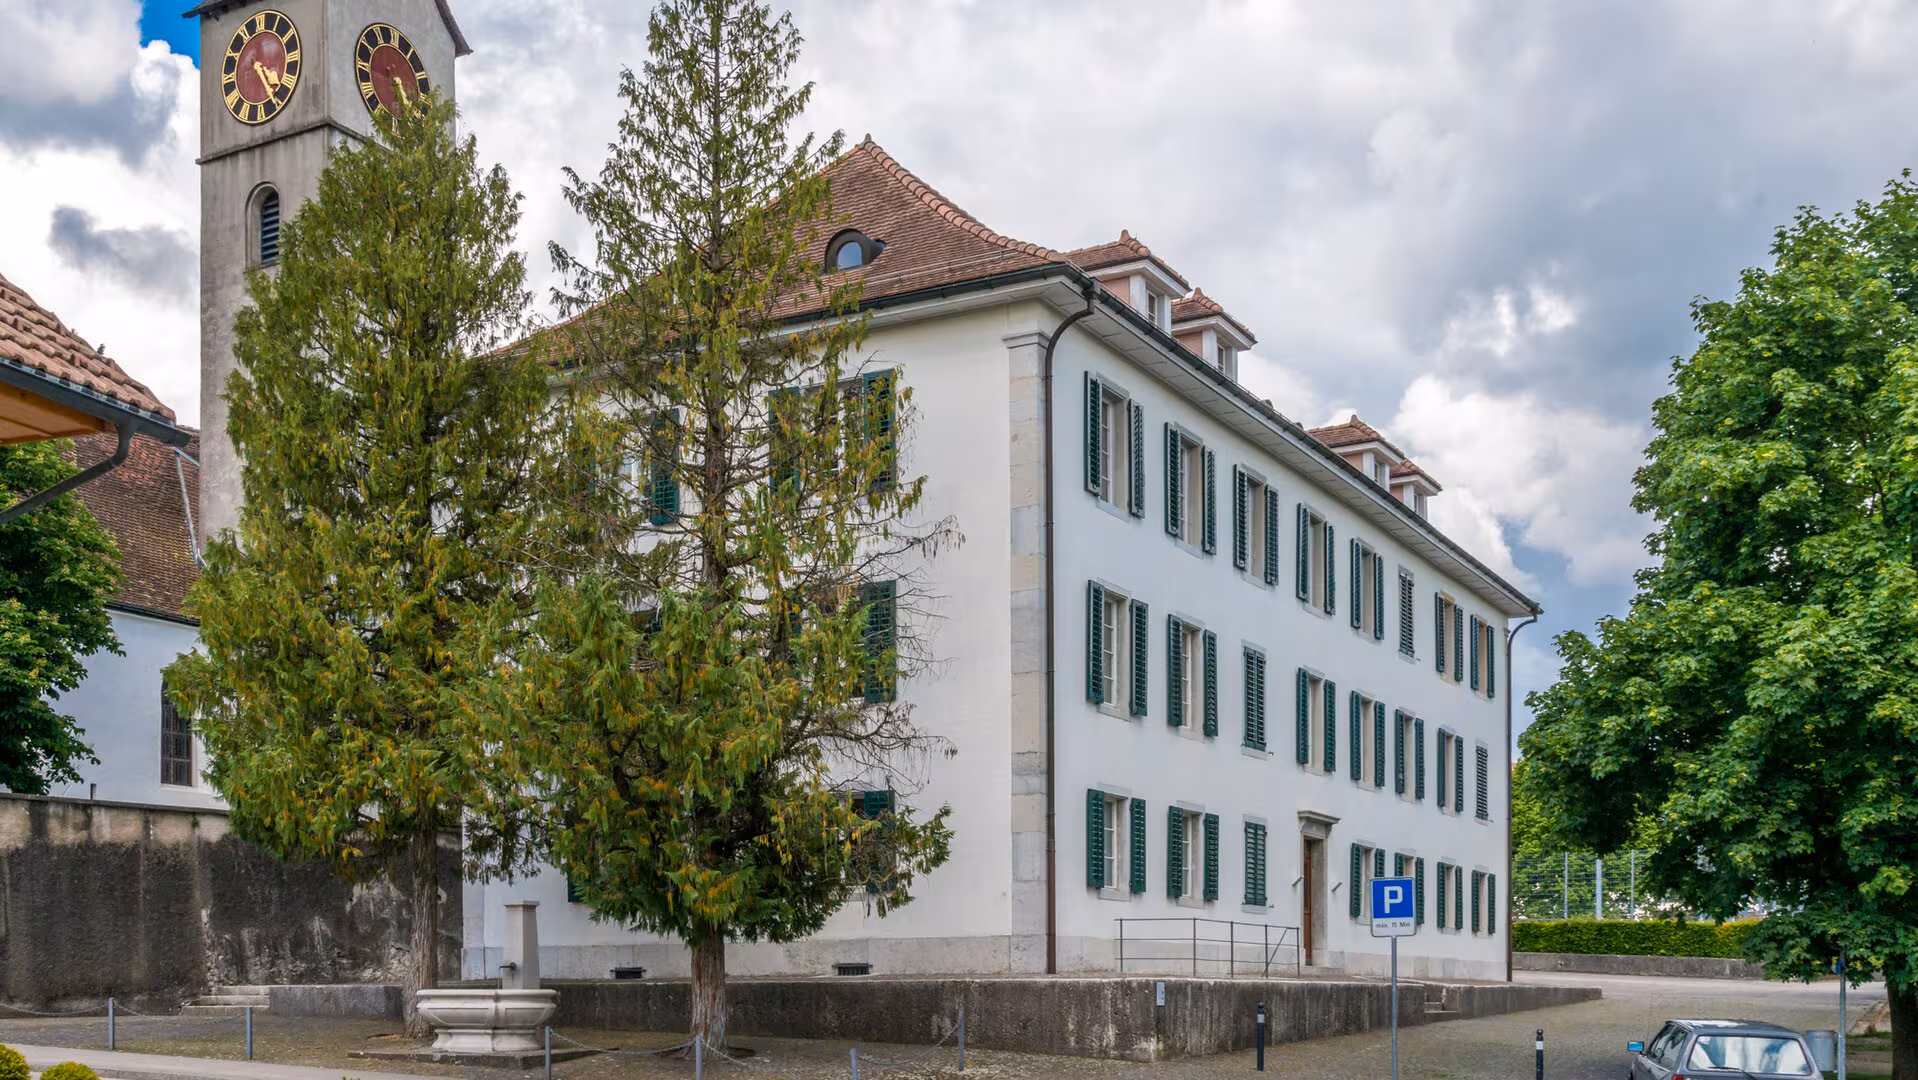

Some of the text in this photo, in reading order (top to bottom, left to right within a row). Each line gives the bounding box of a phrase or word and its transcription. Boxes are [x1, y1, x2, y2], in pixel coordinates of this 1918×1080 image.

[255, 14, 266, 32] XII
[273, 15, 280, 31] I
[239, 25, 250, 43] XI
[282, 28, 294, 43] II
[373, 26, 385, 44] XI
[389, 28, 400, 48] XII
[361, 36, 373, 54] X
[226, 47, 240, 60] X
[286, 49, 300, 62] III
[406, 47, 414, 60] I
[357, 57, 370, 72] IX
[223, 72, 235, 84] IX
[281, 73, 296, 89] IIII
[416, 71, 427, 80] II
[361, 82, 374, 99] VIII
[226, 89, 239, 109] VIII
[239, 101, 250, 121] VII
[257, 104, 266, 120] VI
[1384, 886, 1403, 913] P
